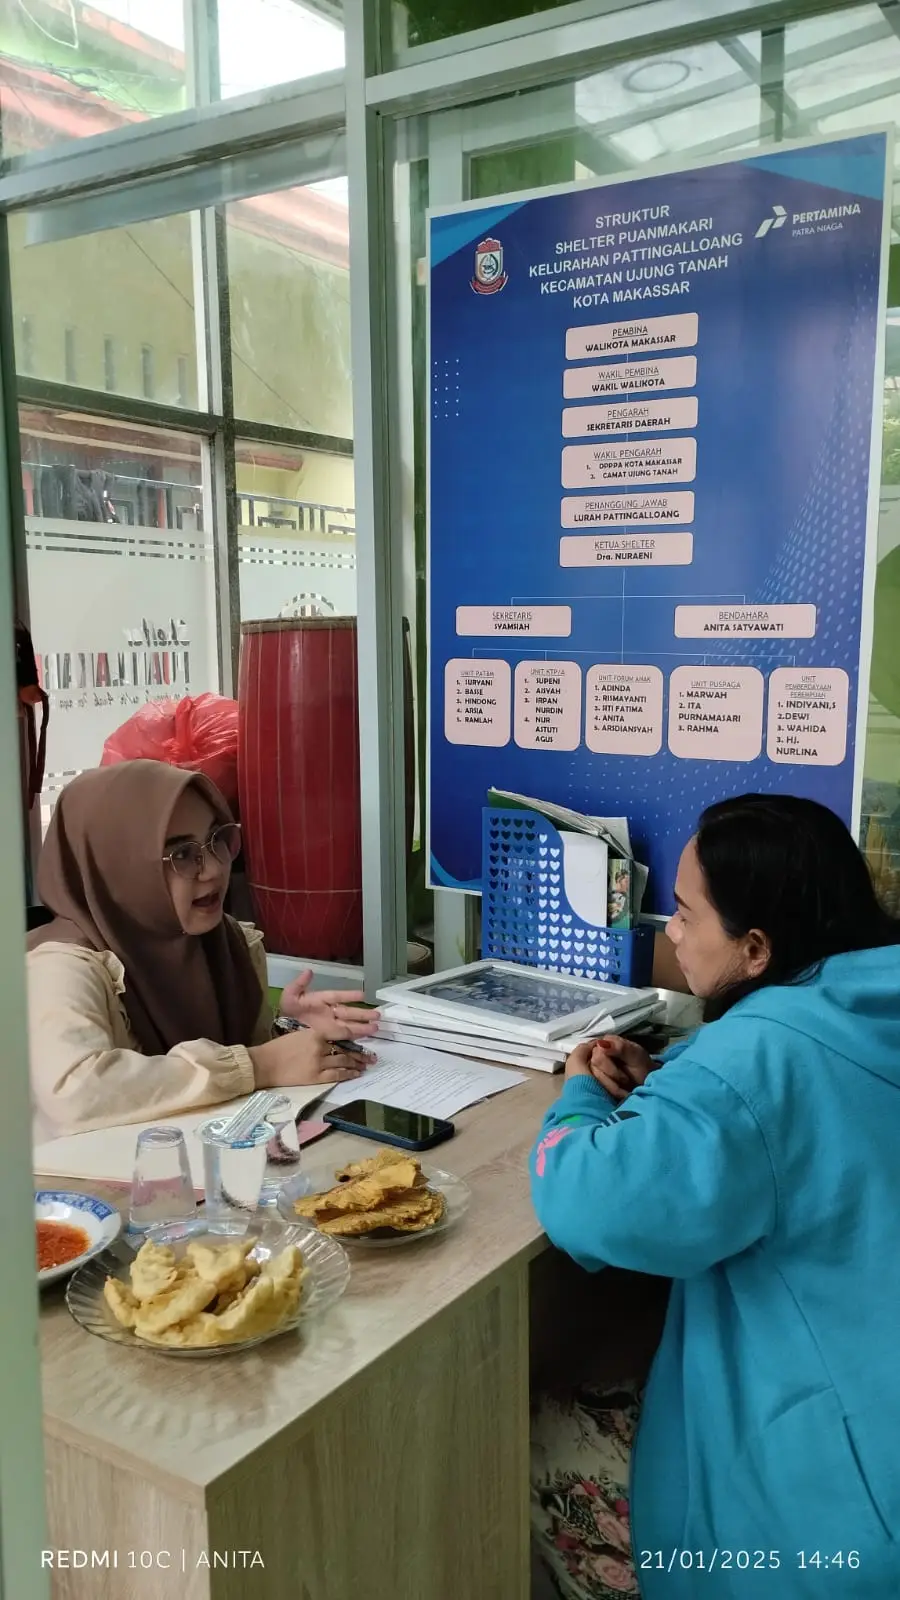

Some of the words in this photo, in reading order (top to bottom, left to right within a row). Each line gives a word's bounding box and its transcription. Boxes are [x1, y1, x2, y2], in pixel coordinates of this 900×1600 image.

[595, 204, 670, 229] STRUKTUR
[792, 203, 861, 225] PERTAMINA
[792, 227, 815, 237] PATRA
[817, 222, 843, 233] NIAGA
[555, 233, 616, 256] SHELTER
[618, 217, 713, 246] PUANMAKARI
[529, 254, 609, 279] KELURAHAN
[612, 232, 743, 265] PATTINGALLOANG
[540, 271, 622, 296] KECAMATAN
[626, 263, 675, 283] UJUNG
[679, 254, 729, 275] TANAH
[573, 291, 610, 309] KOTA
[613, 280, 690, 304] MAKASSAR
[612, 325, 648, 337] PEMBINA
[586, 340, 629, 352] WALIKOTA
[631, 334, 676, 347] MAKASSAR
[598, 370, 622, 380] WAKIL
[625, 366, 659, 376] PEMBINA
[592, 381, 618, 392] WAKIL
[620, 378, 665, 390] WALIKOTA
[607, 407, 649, 418] PENGARAH
[586, 421, 633, 431] SEKRETARIS
[635, 417, 671, 428] DAERAH
[593, 451, 617, 460] WAKIL
[619, 448, 662, 458] PENGARAH
[624, 460, 644, 468] KOTA
[645, 457, 682, 466] MAKASSAR
[603, 471, 626, 479] CAMAT
[628, 469, 651, 478] UJUNG
[653, 468, 678, 476] TANAH
[585, 500, 638, 510] PENANGGUNG
[641, 499, 668, 508] JAWAB
[574, 513, 600, 522] LURAH
[603, 510, 680, 521] PATTINGALLOANG
[594, 541, 619, 549] KETUA
[621, 540, 655, 548] SHELTER
[596, 553, 613, 561] Dra.
[615, 551, 653, 560] NURAENI
[492, 611, 533, 620] SEKRETARIS
[718, 611, 769, 621] BENDAHARA
[494, 623, 530, 631] SYAMSIAH
[703, 623, 731, 632] ANITA
[732, 623, 784, 632] SATYAWATI
[602, 695, 646, 703] RISMAYANTI
[686, 691, 727, 699] MARWAH
[688, 702, 701, 710] ITA
[678, 713, 741, 722] PURNAMASARI
[687, 725, 719, 733] RAHMA
[786, 725, 827, 733] WAHIDA
[786, 736, 799, 744] HJ.
[776, 747, 818, 757] NURLINA
